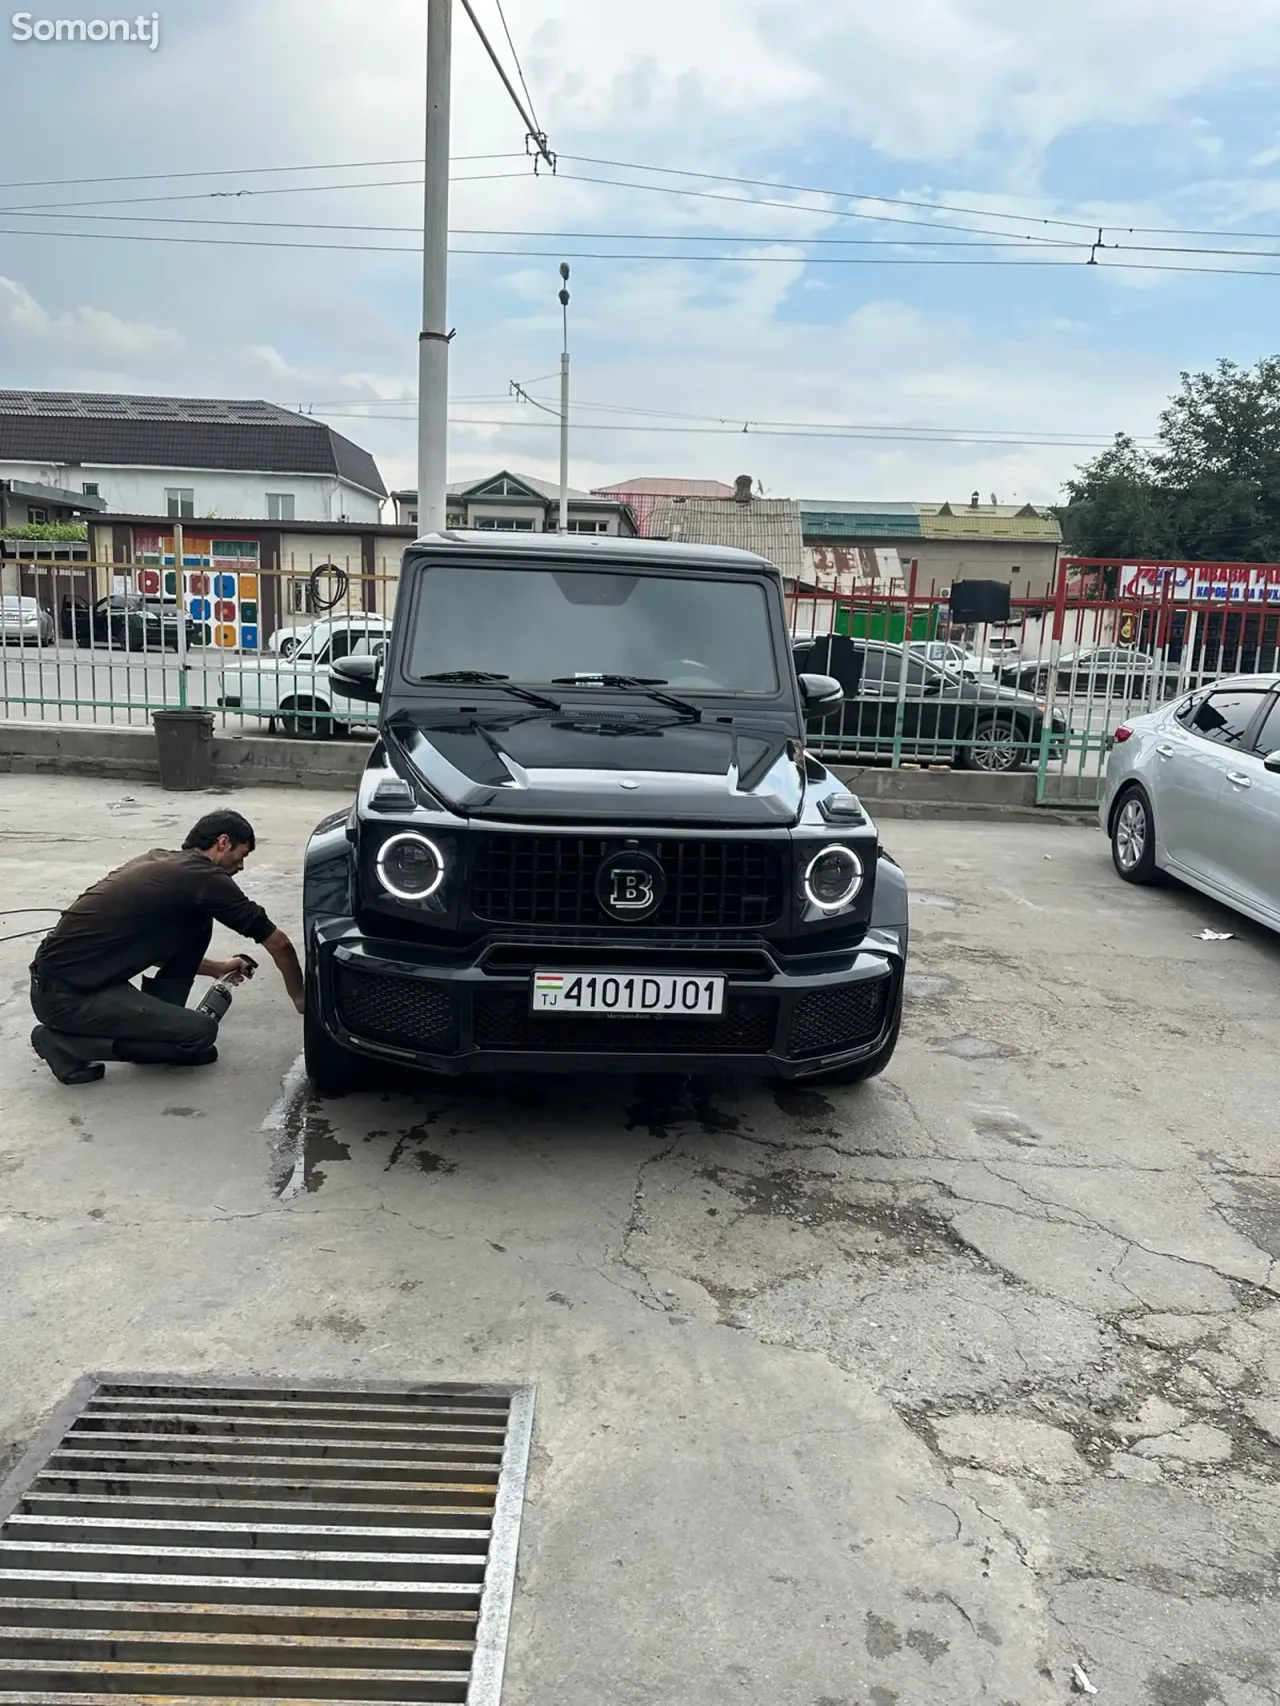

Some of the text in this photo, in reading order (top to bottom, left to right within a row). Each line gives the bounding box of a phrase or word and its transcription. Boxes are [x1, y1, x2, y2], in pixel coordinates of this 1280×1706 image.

[610, 869, 653, 908] B
[542, 976, 715, 1010] TJ 4101DJ01
